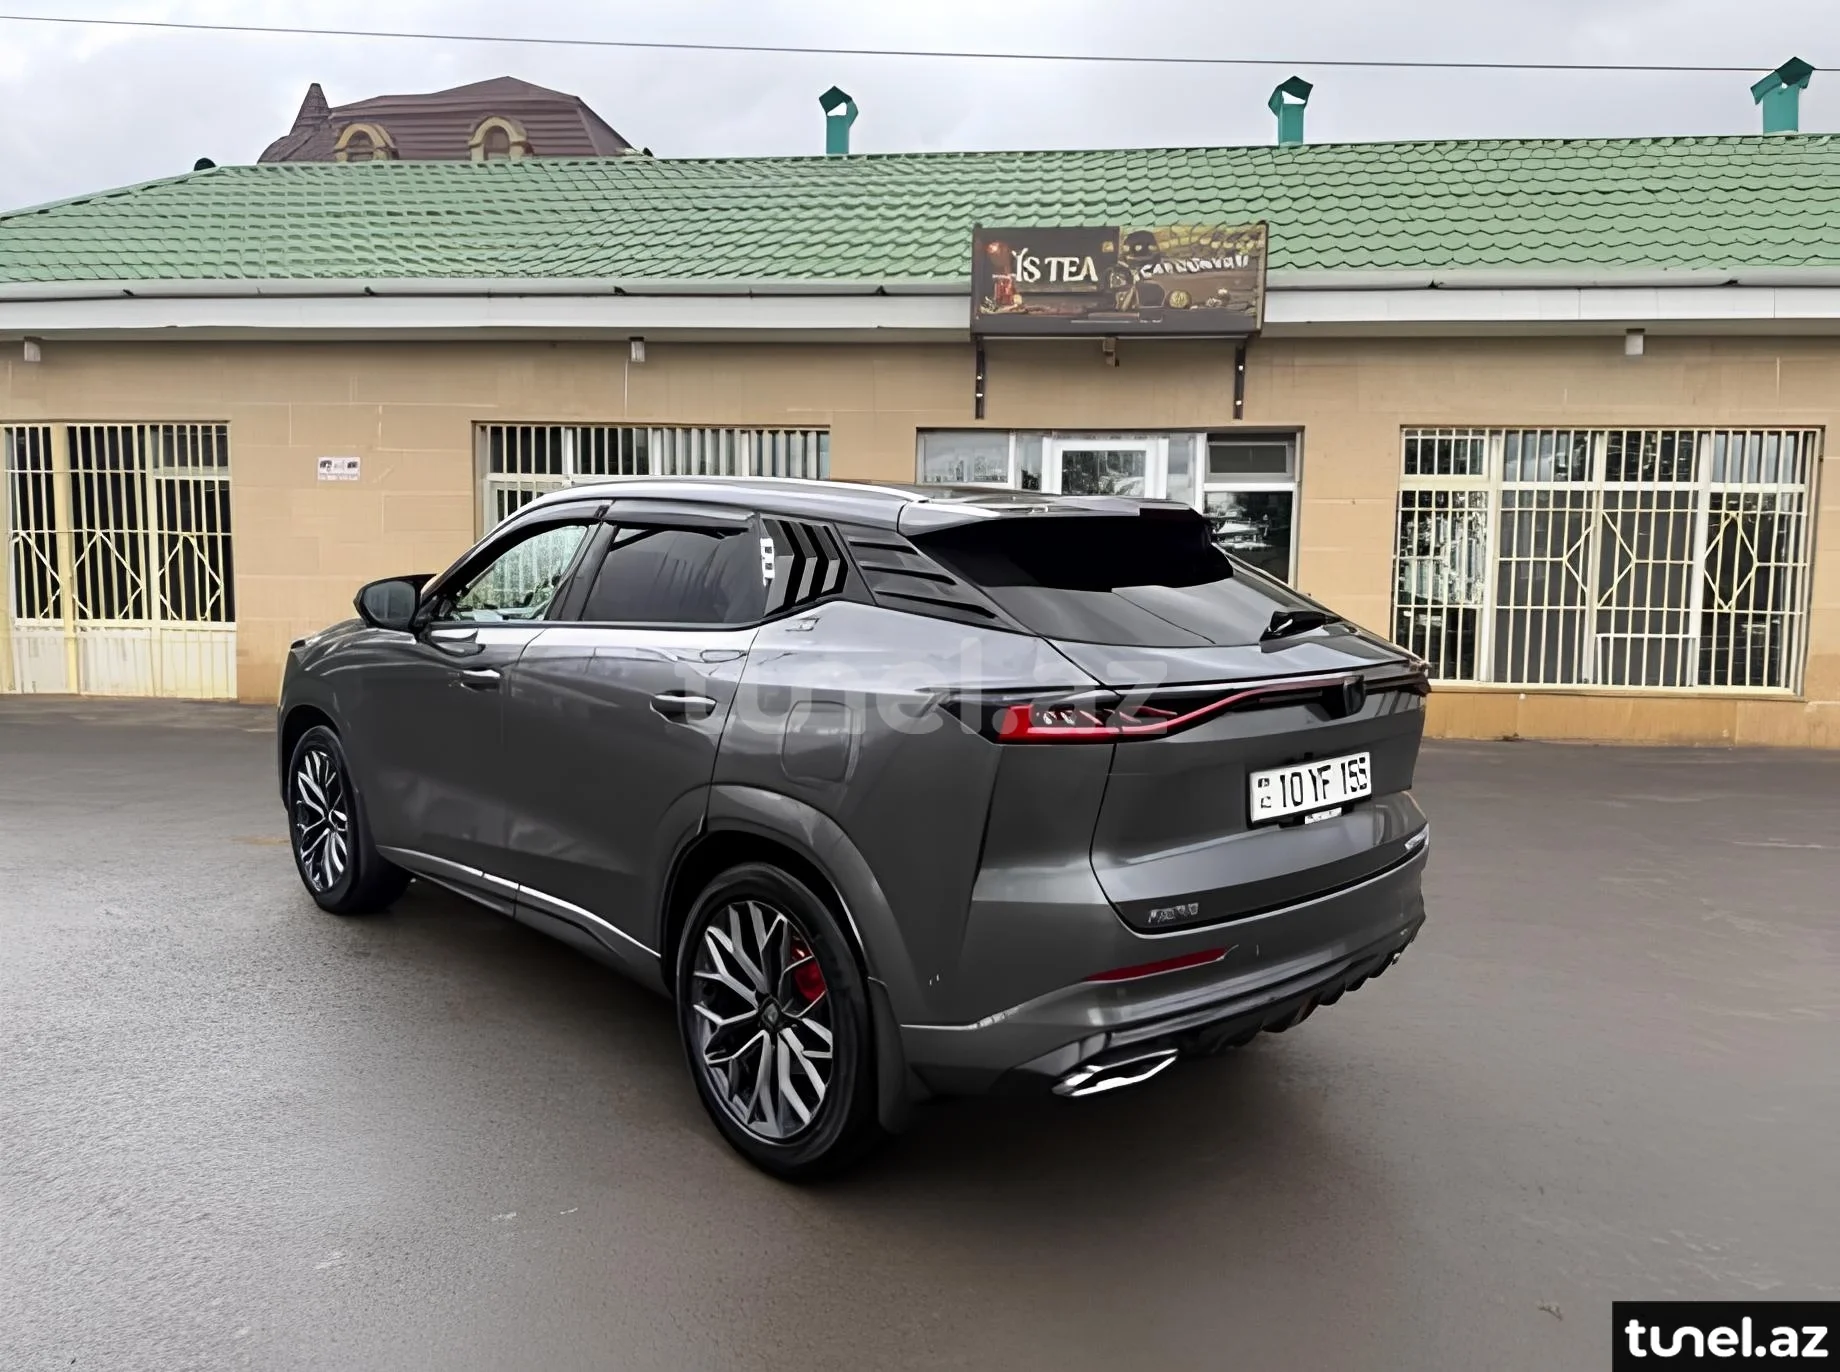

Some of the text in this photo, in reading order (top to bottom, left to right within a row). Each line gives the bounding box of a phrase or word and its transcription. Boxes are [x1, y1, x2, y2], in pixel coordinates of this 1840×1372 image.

[1044, 256, 1098, 282] TEA
[1279, 771, 1304, 808] 10
[1307, 764, 1332, 802] YF
